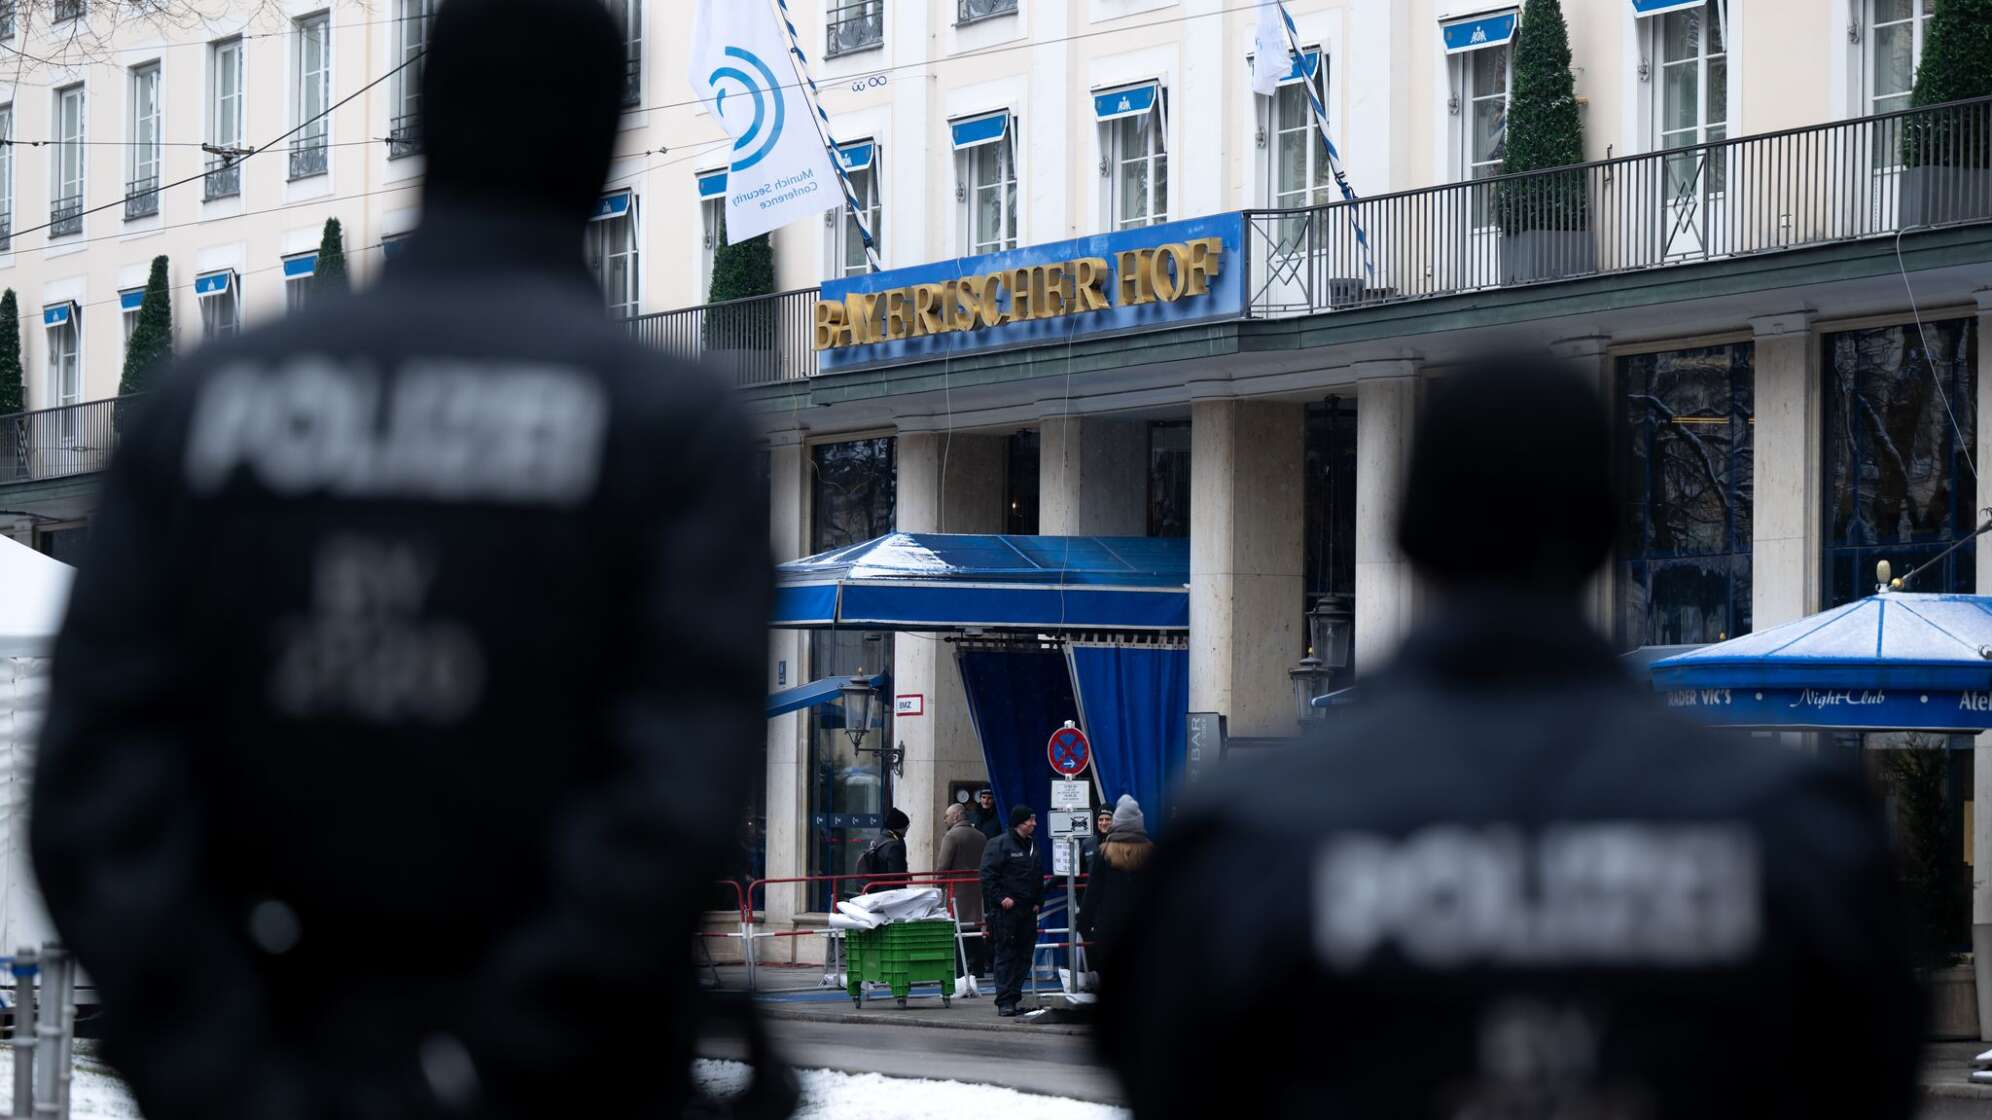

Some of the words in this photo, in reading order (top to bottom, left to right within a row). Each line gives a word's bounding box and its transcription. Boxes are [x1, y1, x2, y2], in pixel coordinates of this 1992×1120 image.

[812, 257, 1111, 351] BAYERISCHER
[1114, 236, 1223, 307] HOF
[187, 356, 606, 506] POLIZEI
[1191, 716, 1201, 761] BAR
[1701, 688, 1732, 705] VIC'S
[1789, 689, 1842, 709] Night
[1845, 690, 1886, 706] Club
[1313, 822, 1763, 968] POLIZEI
